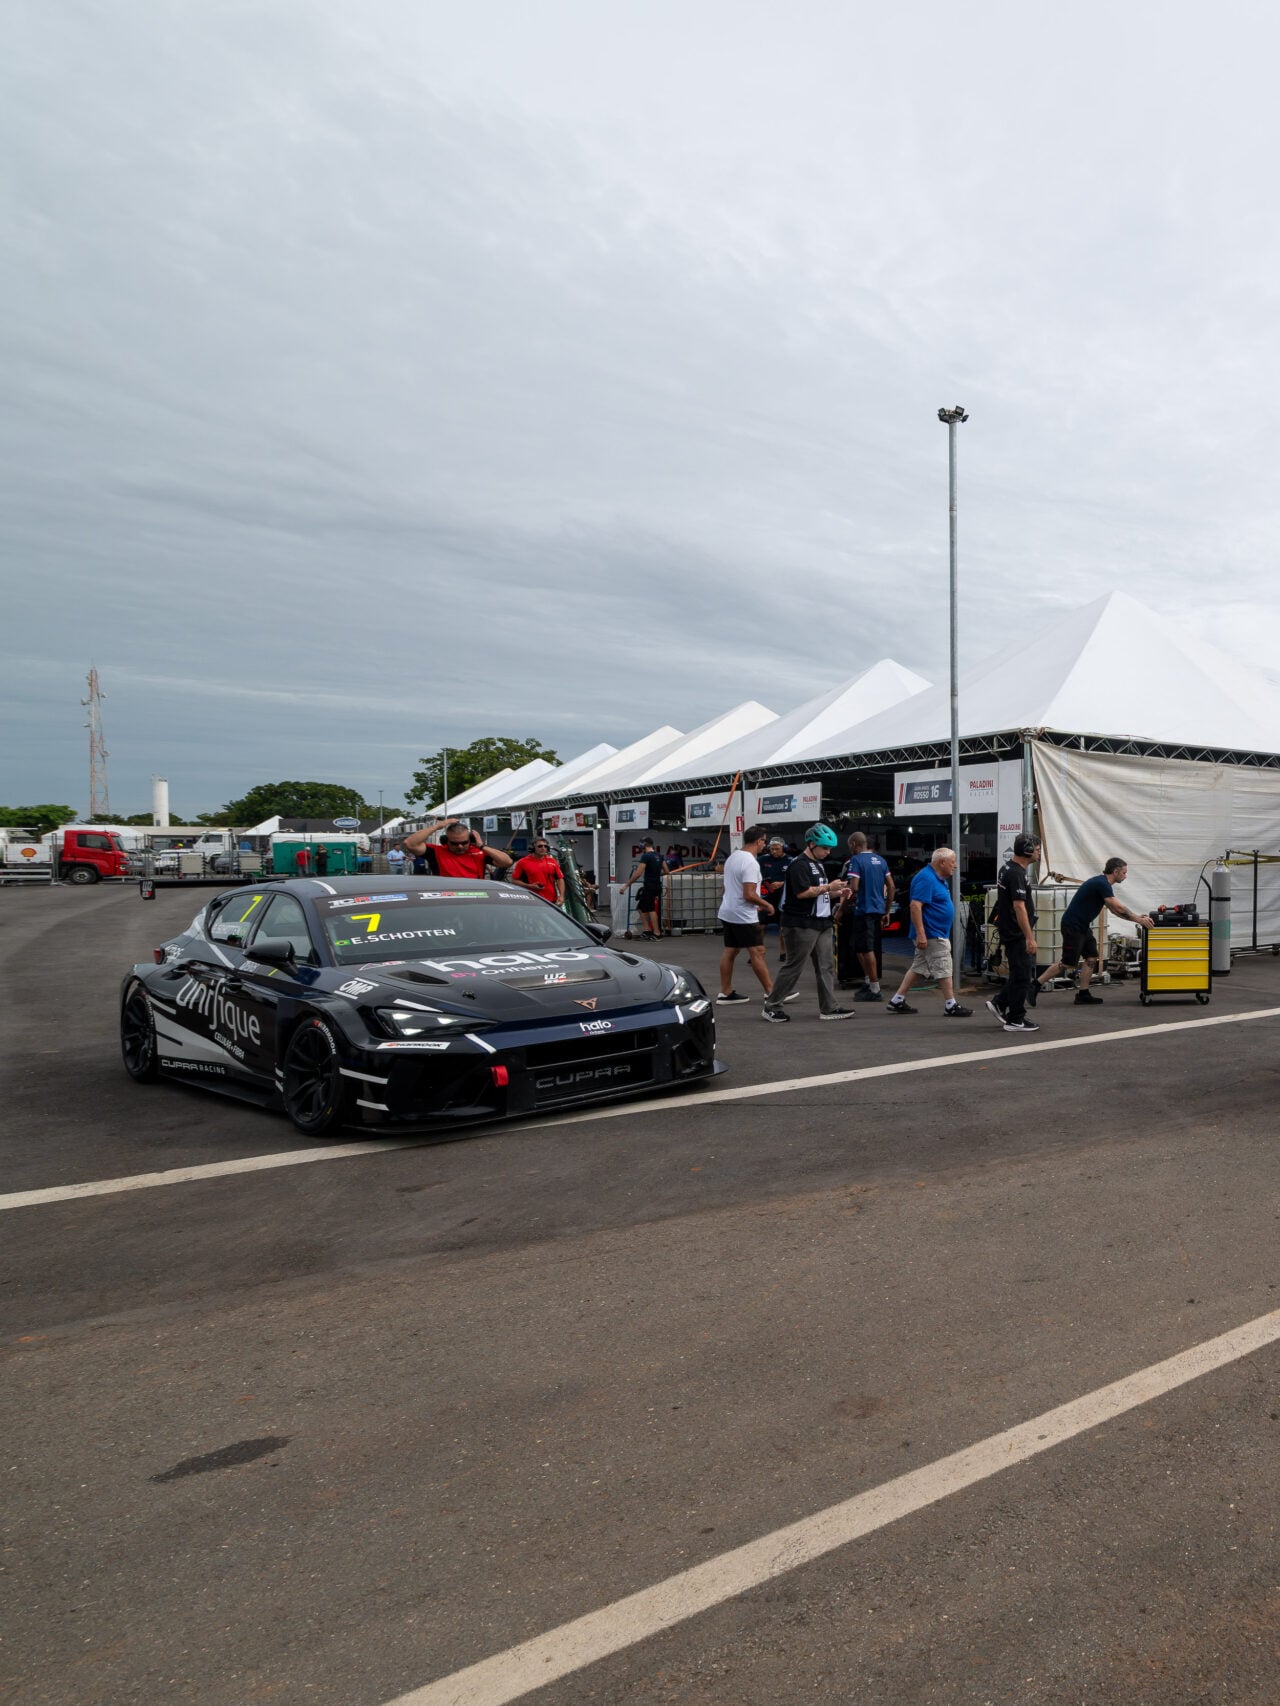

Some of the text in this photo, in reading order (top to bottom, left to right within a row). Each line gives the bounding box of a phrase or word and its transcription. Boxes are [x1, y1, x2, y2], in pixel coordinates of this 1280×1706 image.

[930, 784, 940, 799] 16
[969, 779, 994, 789] PALADINI
[351, 914, 381, 933] 7
[351, 928, 456, 945] E.SCHOTTEN
[339, 980, 374, 996] OMP
[579, 1020, 612, 1032] halo
[161, 1059, 225, 1075] CUPRA RACING
[535, 1064, 632, 1089] CUPRA
